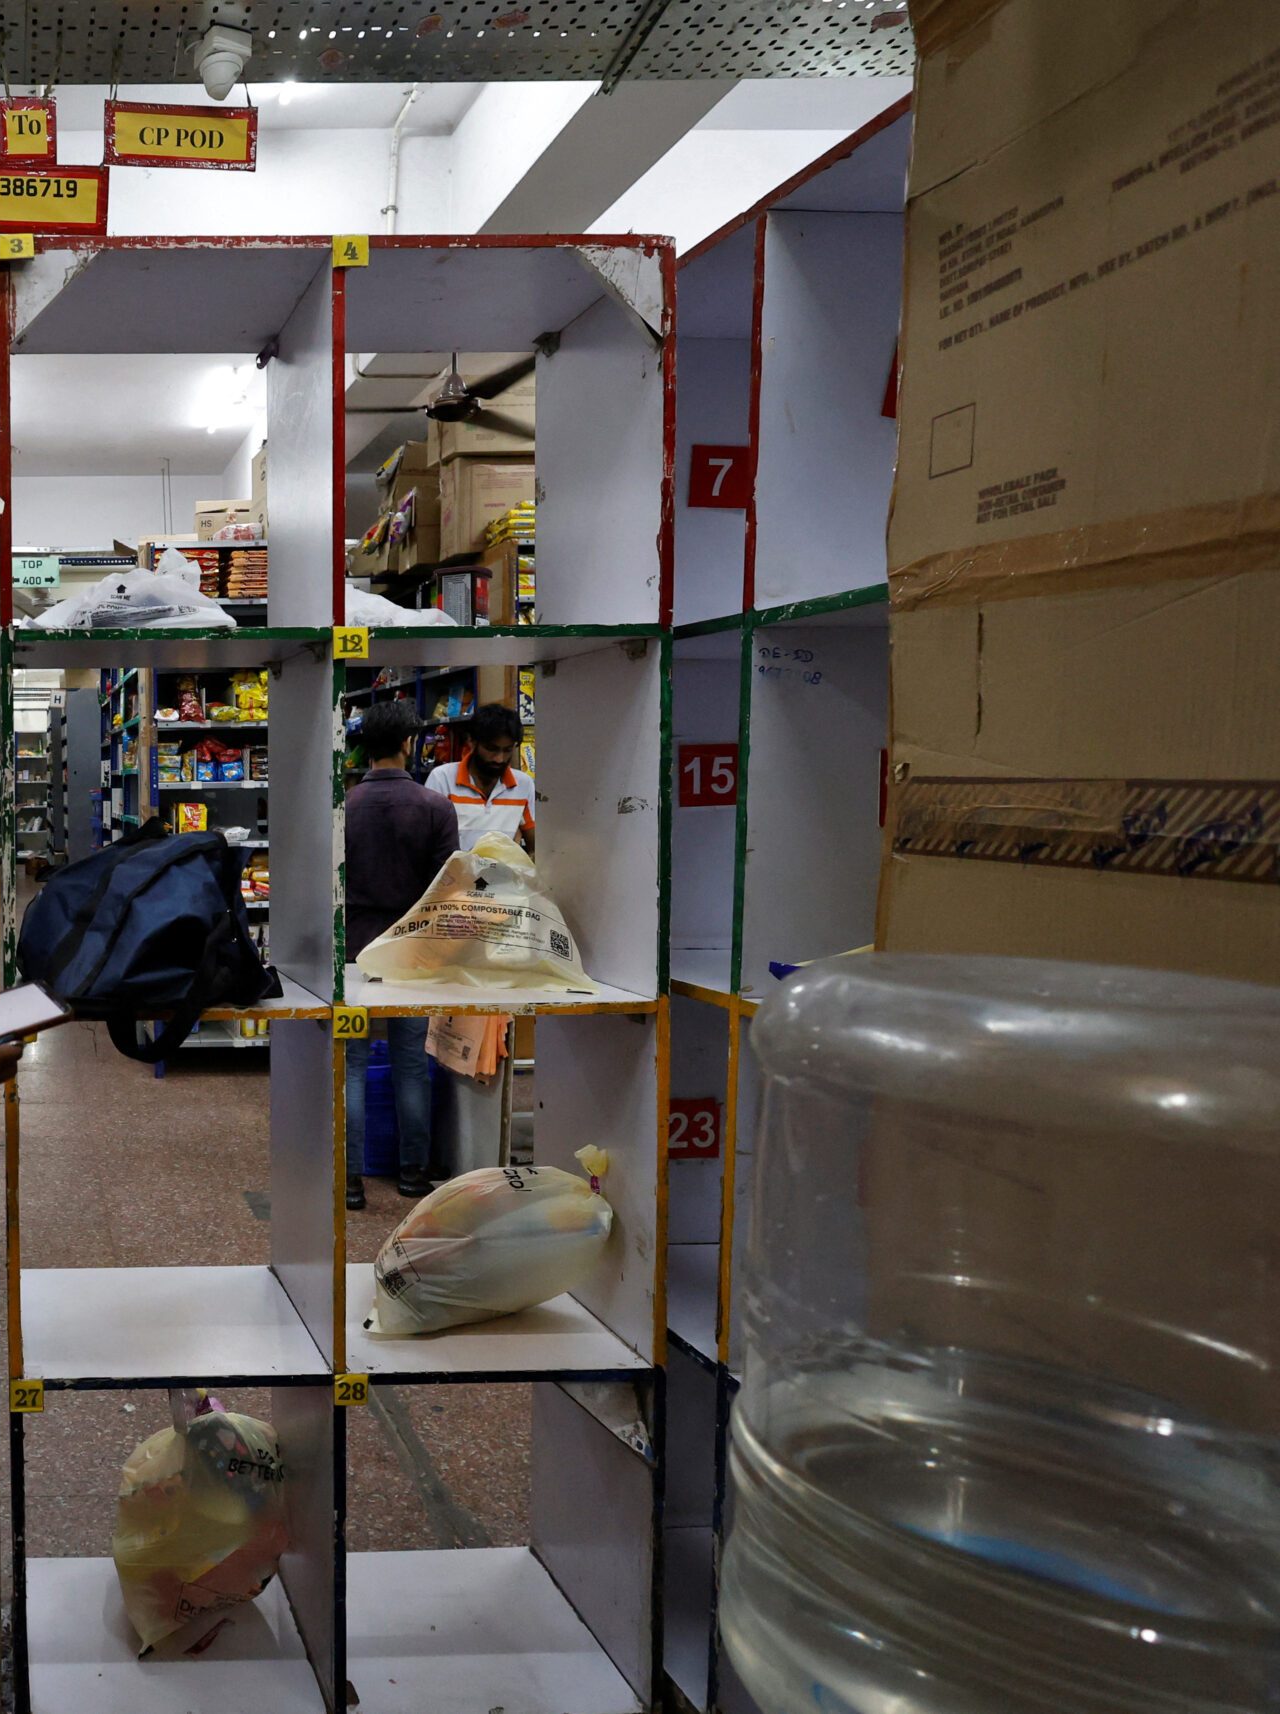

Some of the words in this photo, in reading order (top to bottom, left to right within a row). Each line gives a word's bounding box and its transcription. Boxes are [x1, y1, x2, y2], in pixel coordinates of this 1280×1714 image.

[12, 114, 42, 136] To
[138, 126, 170, 147] CP
[175, 128, 225, 150] POD
[10, 237, 24, 254] 3
[344, 241, 359, 260] 4
[707, 458, 733, 496] 7
[21, 560, 43, 569] TOP
[22, 576, 42, 585] 400
[338, 633, 363, 653] 12
[53, 694, 62, 704] H
[683, 756, 735, 795] 15
[461, 905, 523, 917] COMPOSTABLE
[525, 911, 541, 921] BAG
[336, 1015, 366, 1034] 20
[667, 1112, 716, 1150] 23
[15, 1388, 41, 1408] 27
[337, 1381, 366, 1402] 28
